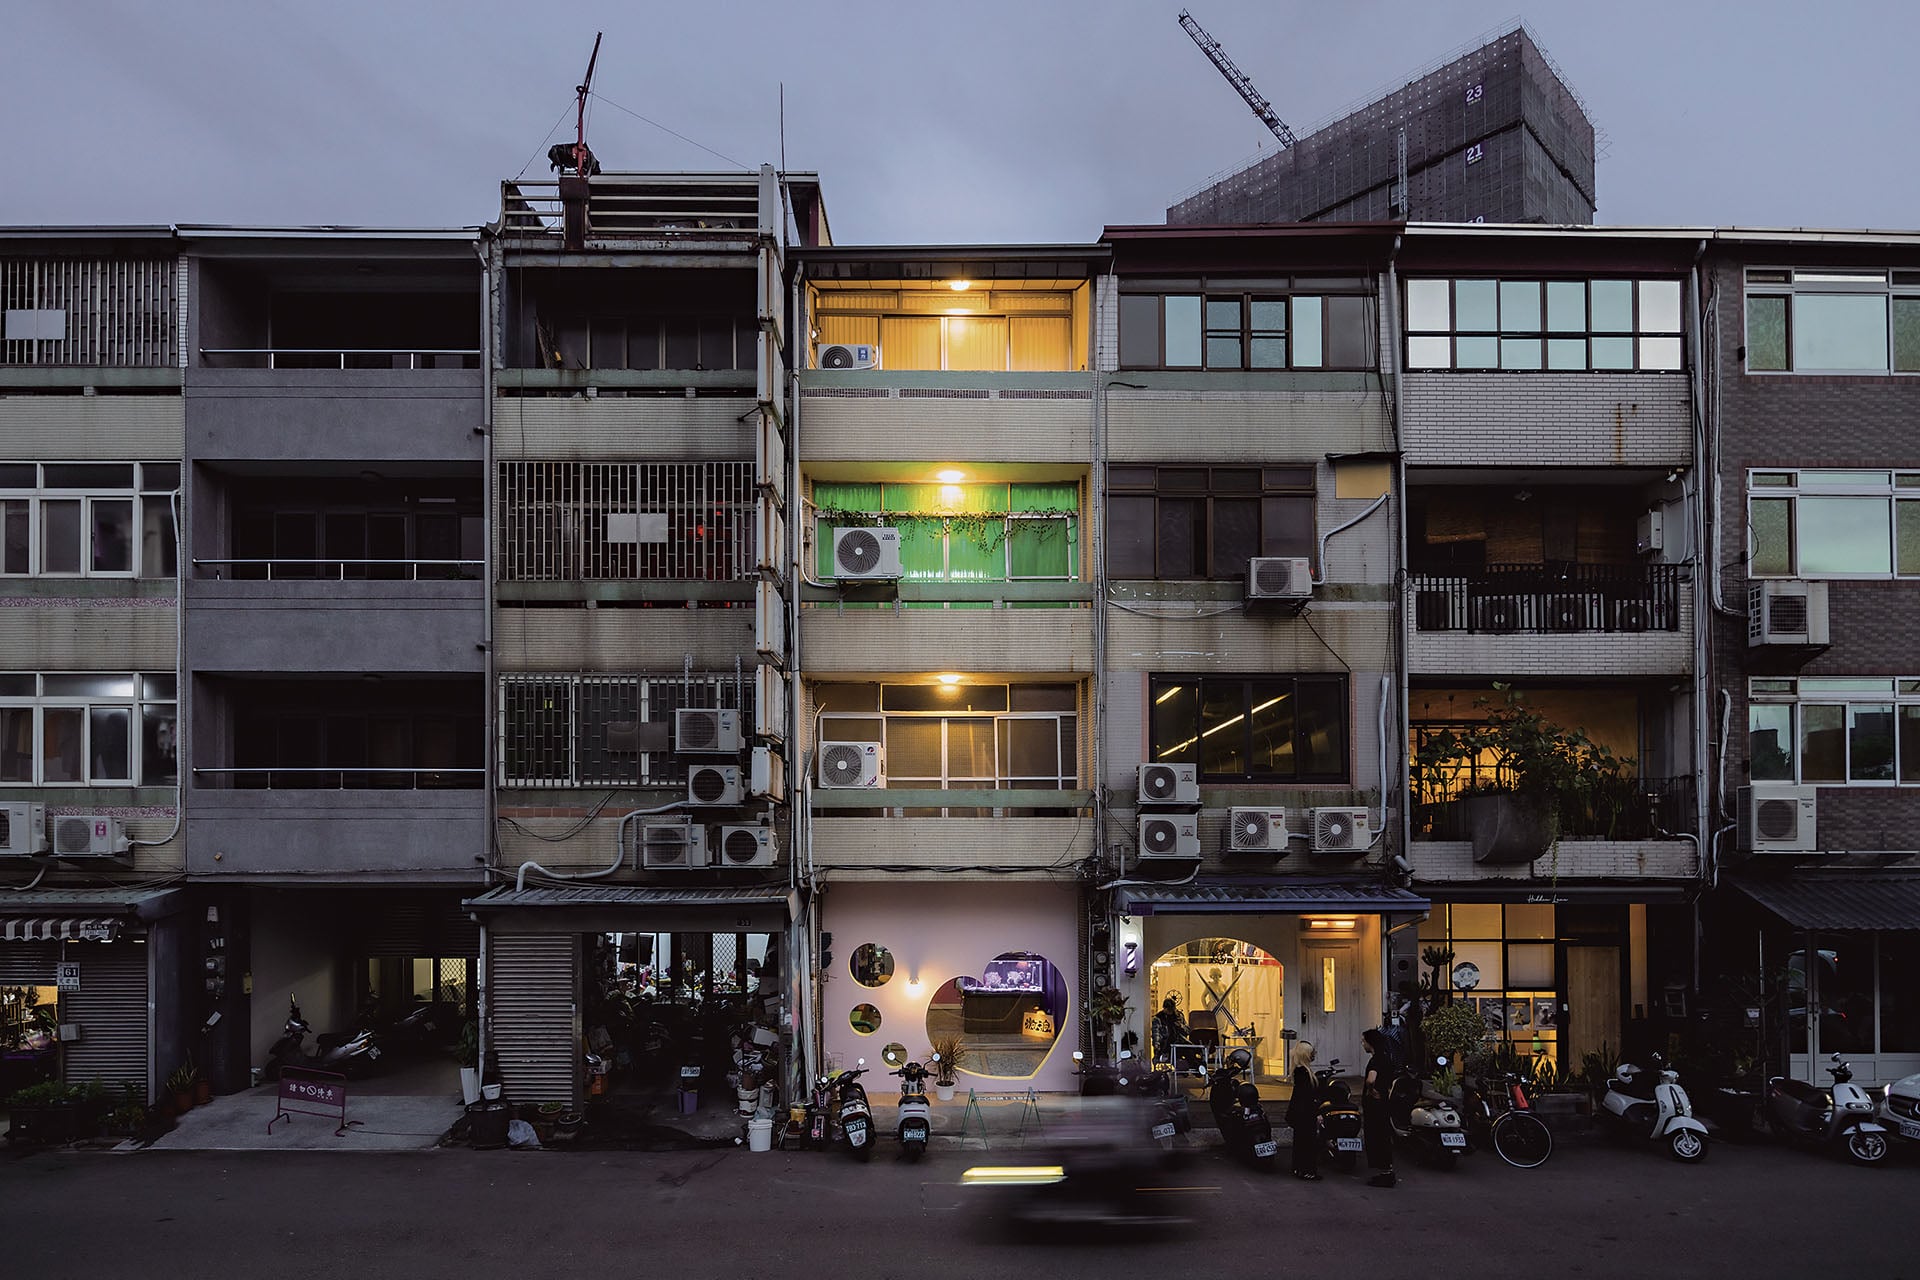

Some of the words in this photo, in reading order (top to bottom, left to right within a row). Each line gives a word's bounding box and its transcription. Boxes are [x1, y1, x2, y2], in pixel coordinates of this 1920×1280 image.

[1466, 84, 1483, 102] 23
[1466, 143, 1483, 162] 21
[65, 968, 77, 976] 61
